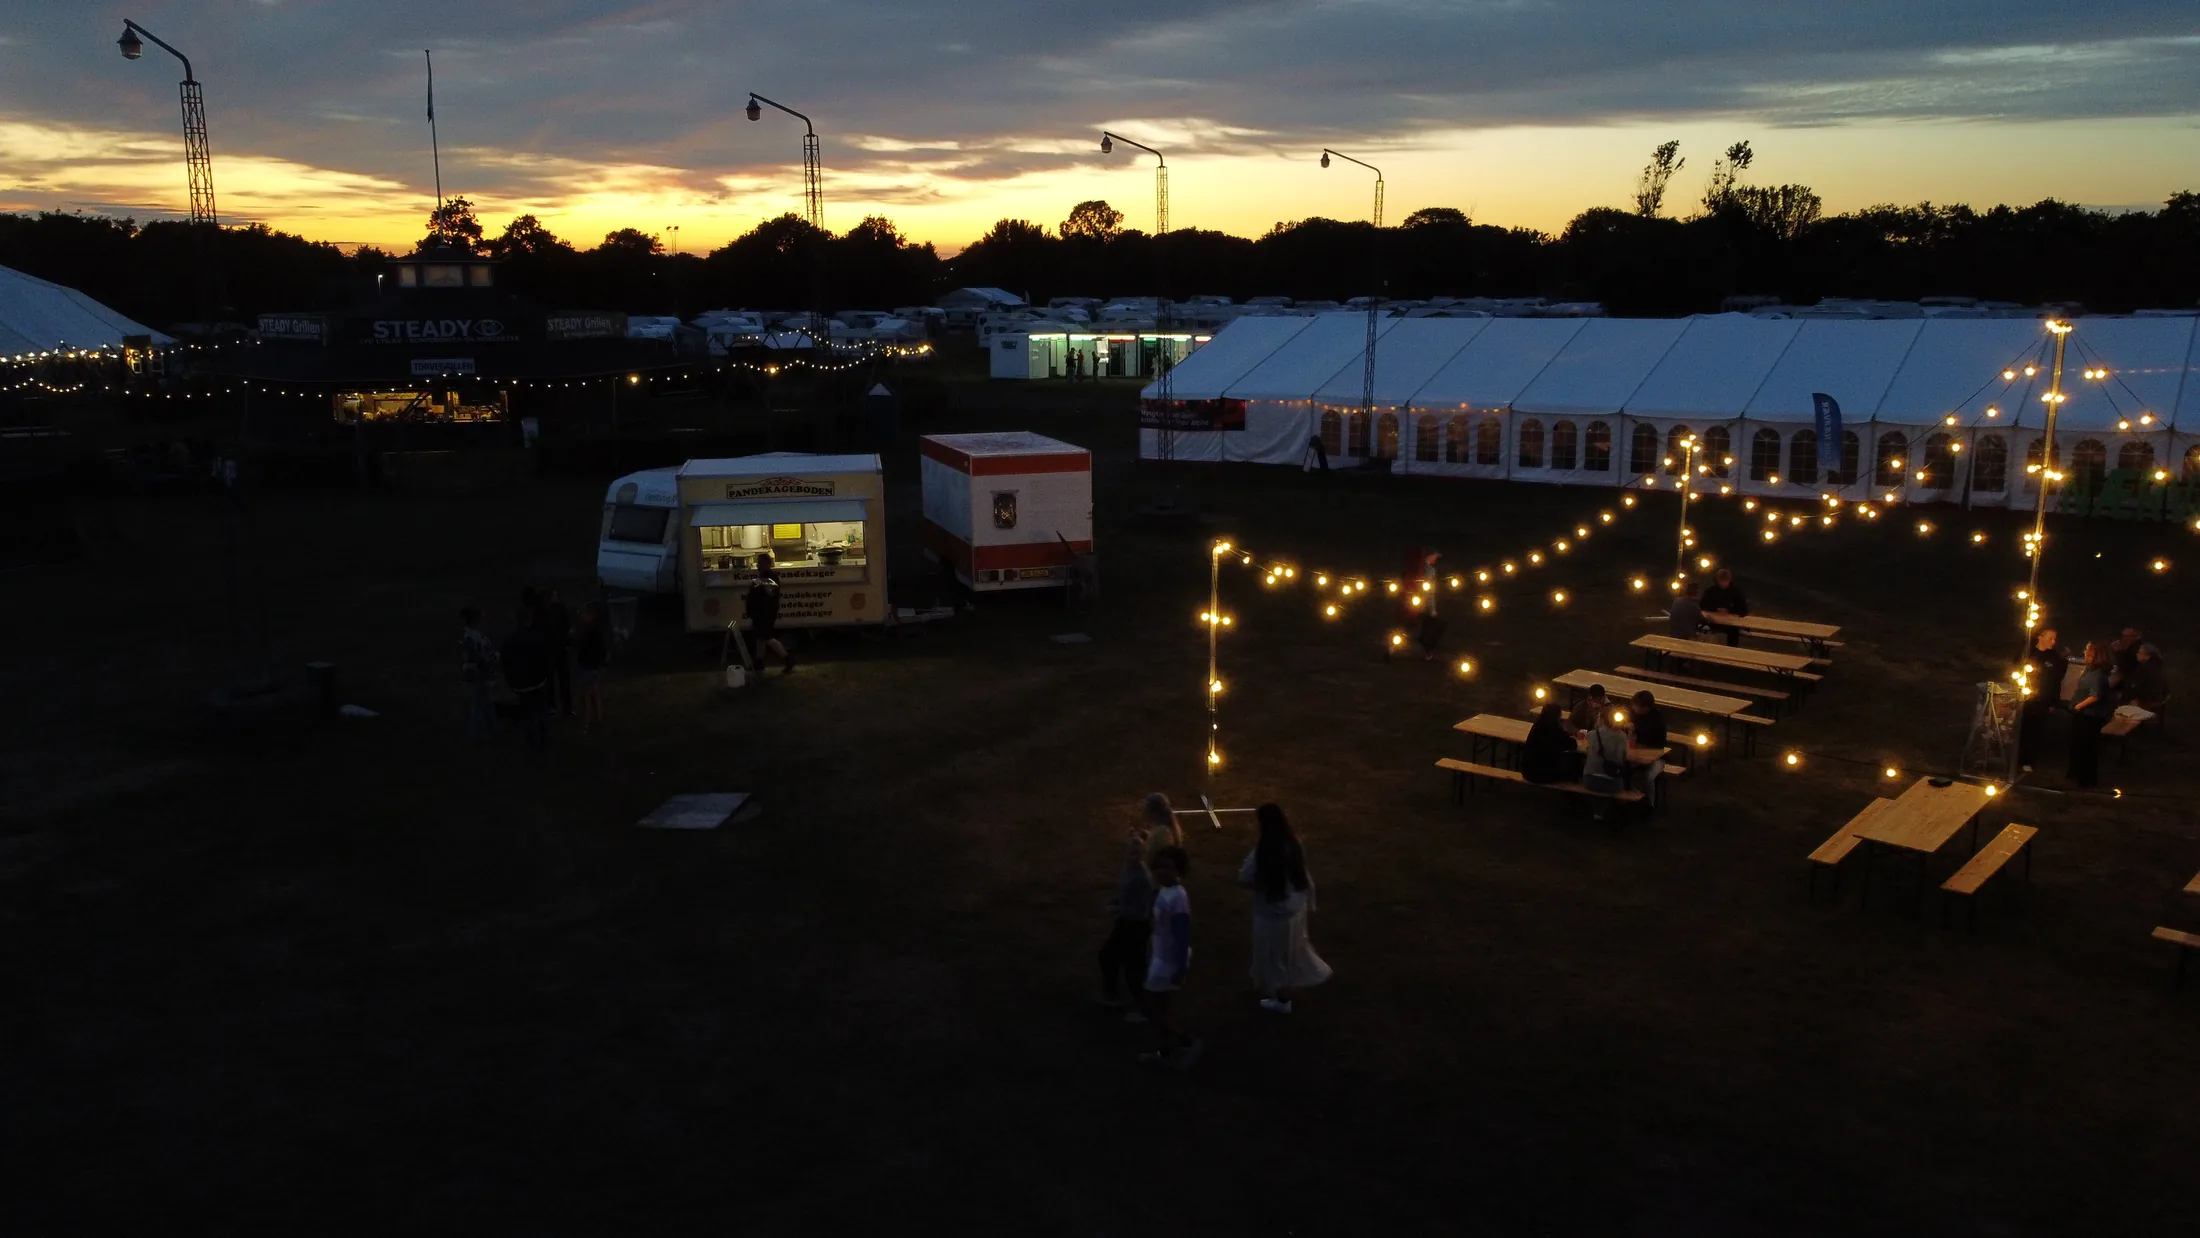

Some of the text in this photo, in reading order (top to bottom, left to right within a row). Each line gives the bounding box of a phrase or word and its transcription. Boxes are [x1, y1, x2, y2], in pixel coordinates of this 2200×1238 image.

[259, 318, 321, 333] STEADY Grillen
[373, 319, 472, 338] STEADY
[547, 318, 582, 332] STEADY
[729, 485, 833, 498] PANDEKAGEBODEN
